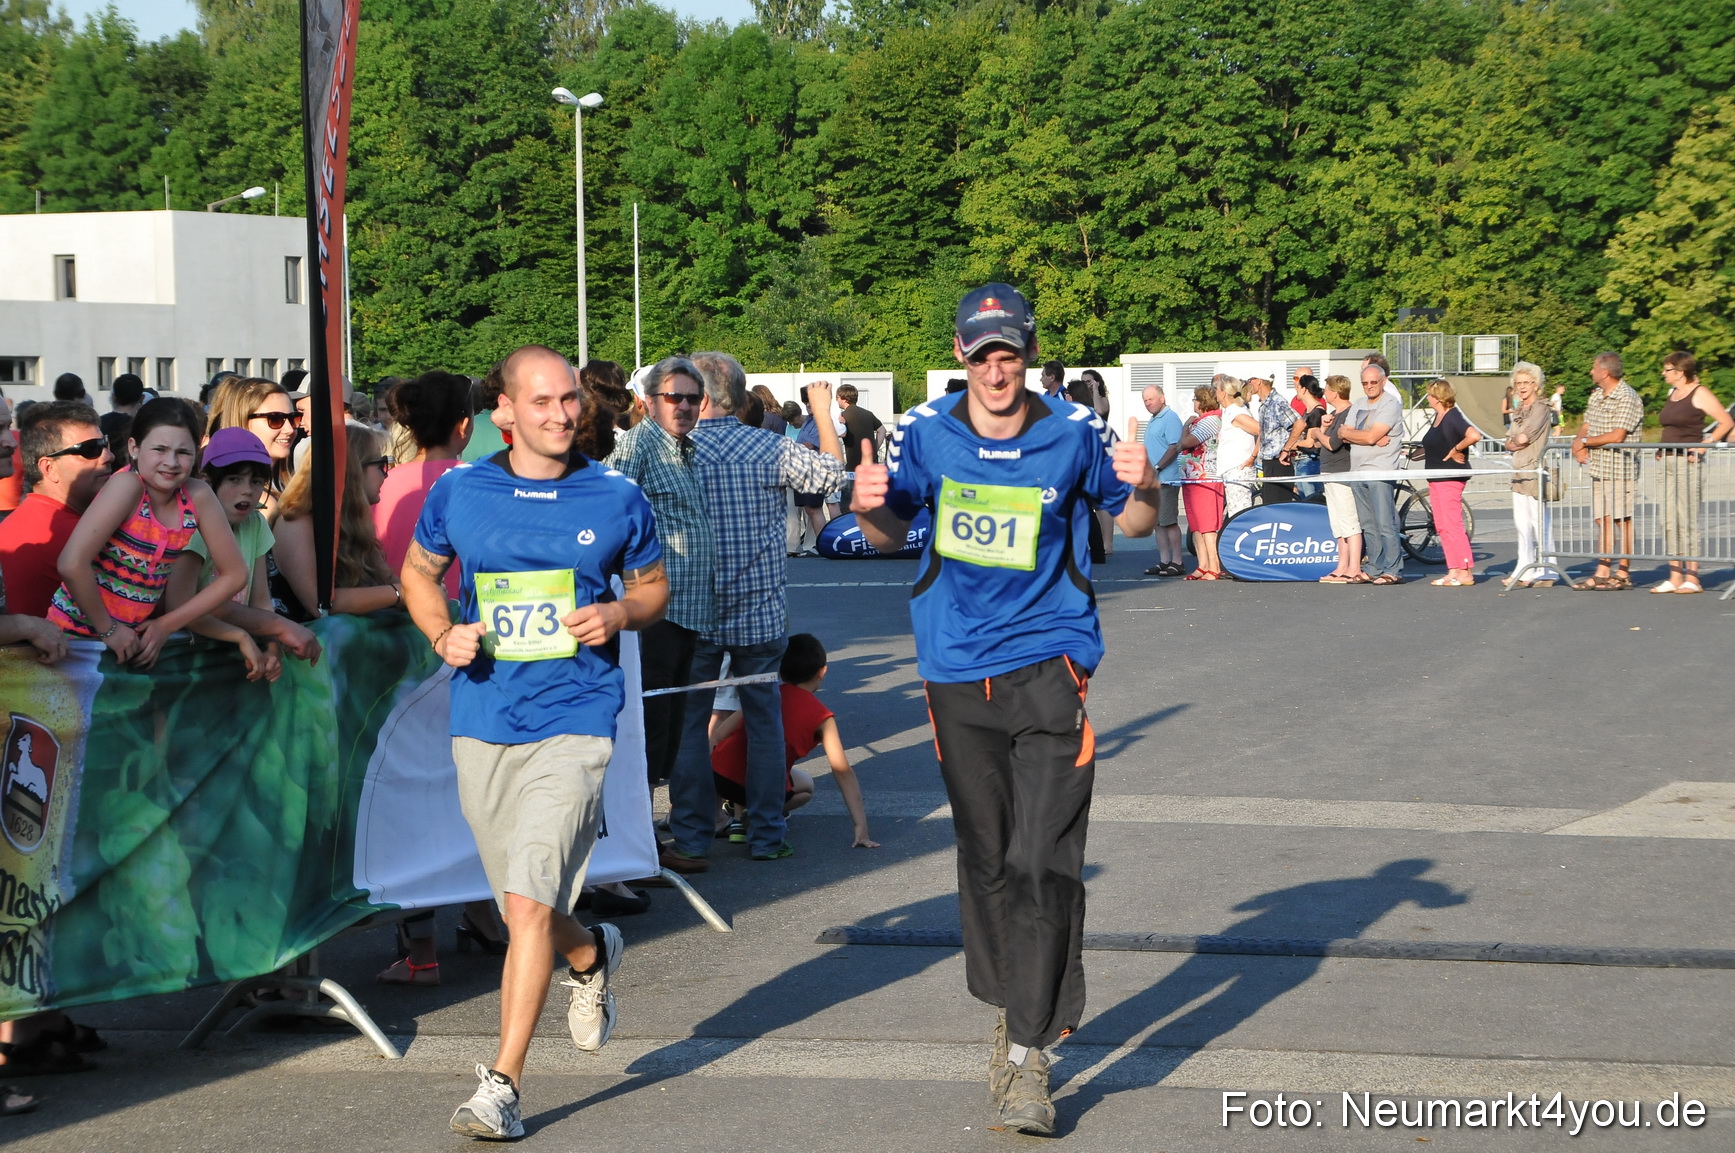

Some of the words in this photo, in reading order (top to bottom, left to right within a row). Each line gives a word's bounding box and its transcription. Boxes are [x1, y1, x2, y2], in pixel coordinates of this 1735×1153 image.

[979, 447, 1021, 459] hummel
[514, 488, 557, 499] hummel
[952, 511, 1016, 548] 691
[1263, 556, 1339, 565] AUTOMOBILE
[492, 603, 559, 637] 673
[10, 813, 34, 841] 1628
